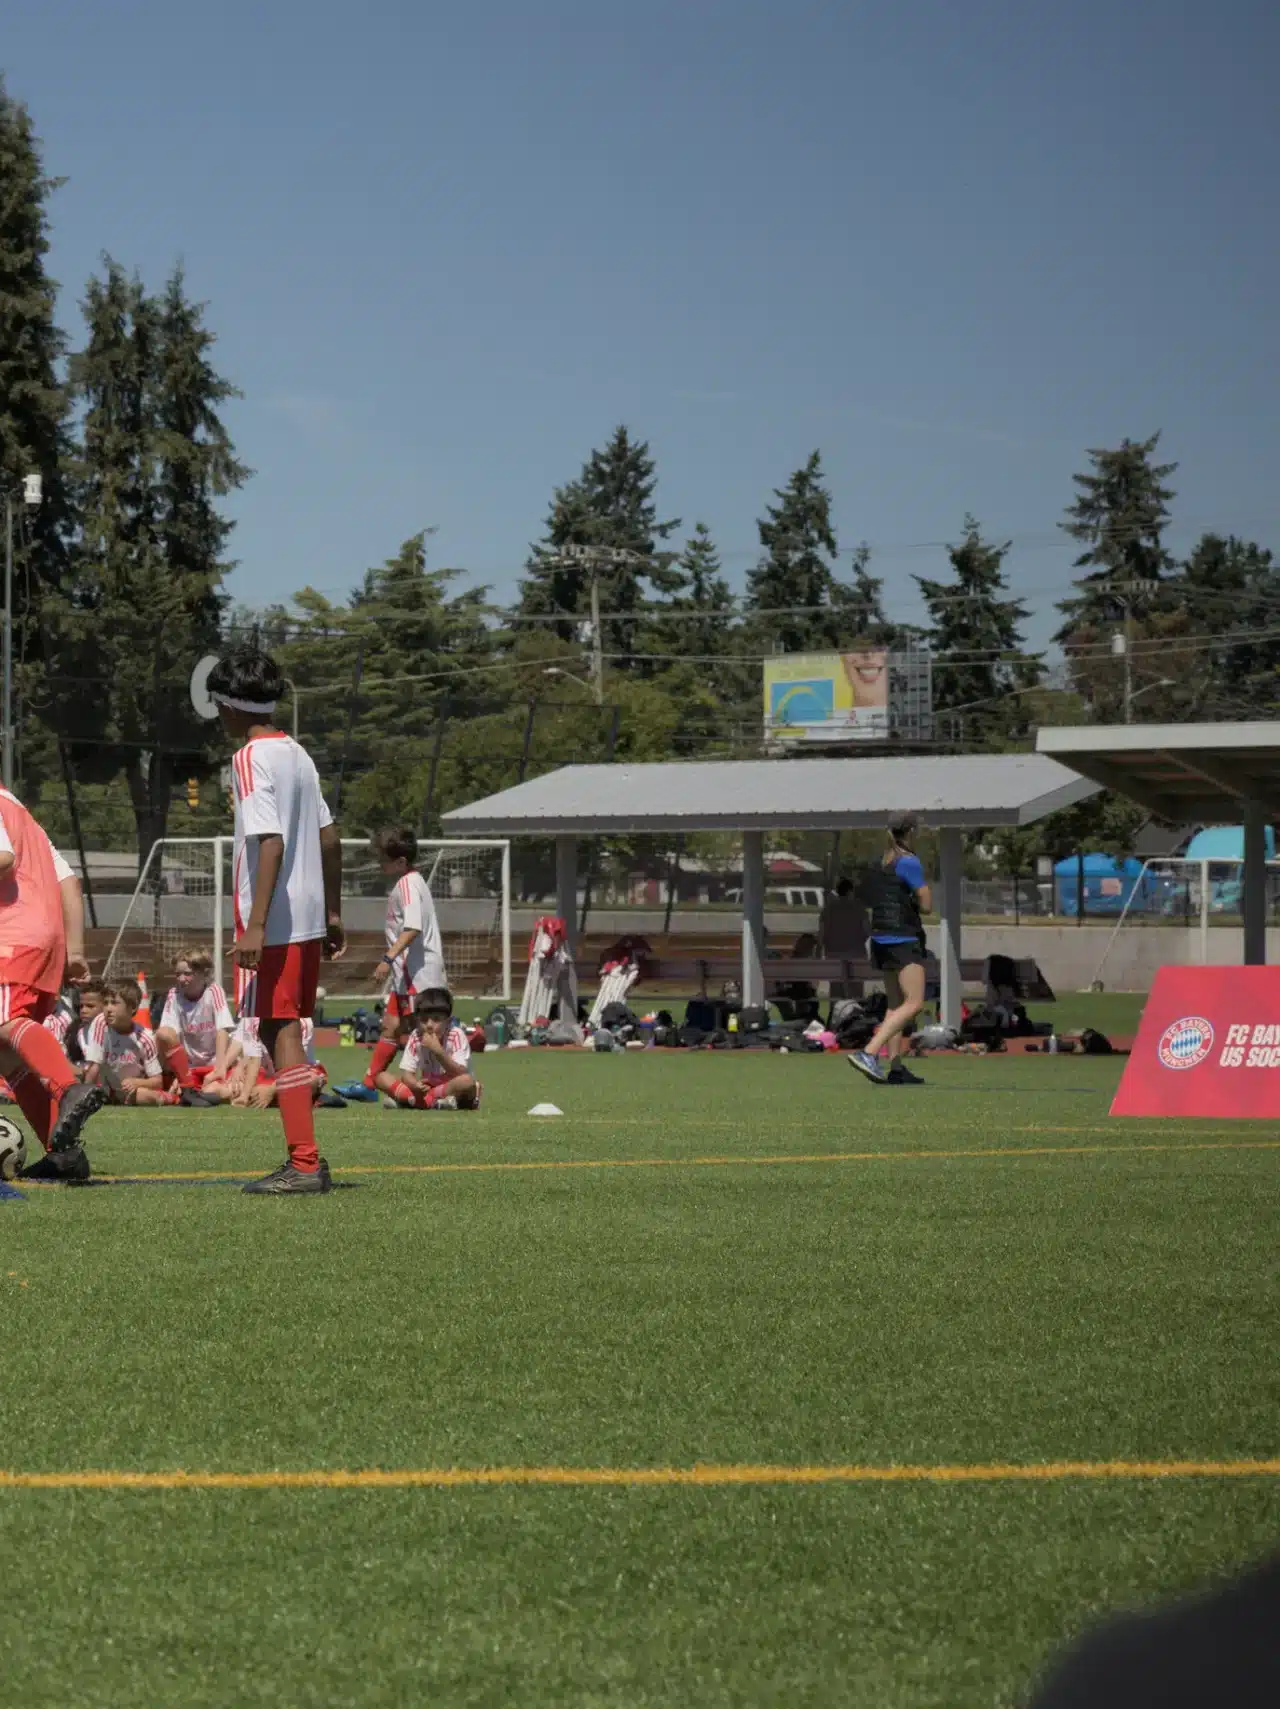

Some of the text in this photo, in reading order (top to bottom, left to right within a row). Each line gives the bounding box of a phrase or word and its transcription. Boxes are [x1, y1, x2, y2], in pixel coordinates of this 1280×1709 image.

[1165, 1019, 1211, 1040] FC BAYERN
[1225, 1024, 1250, 1045] FC
[1219, 1046, 1280, 1067] US SOC
